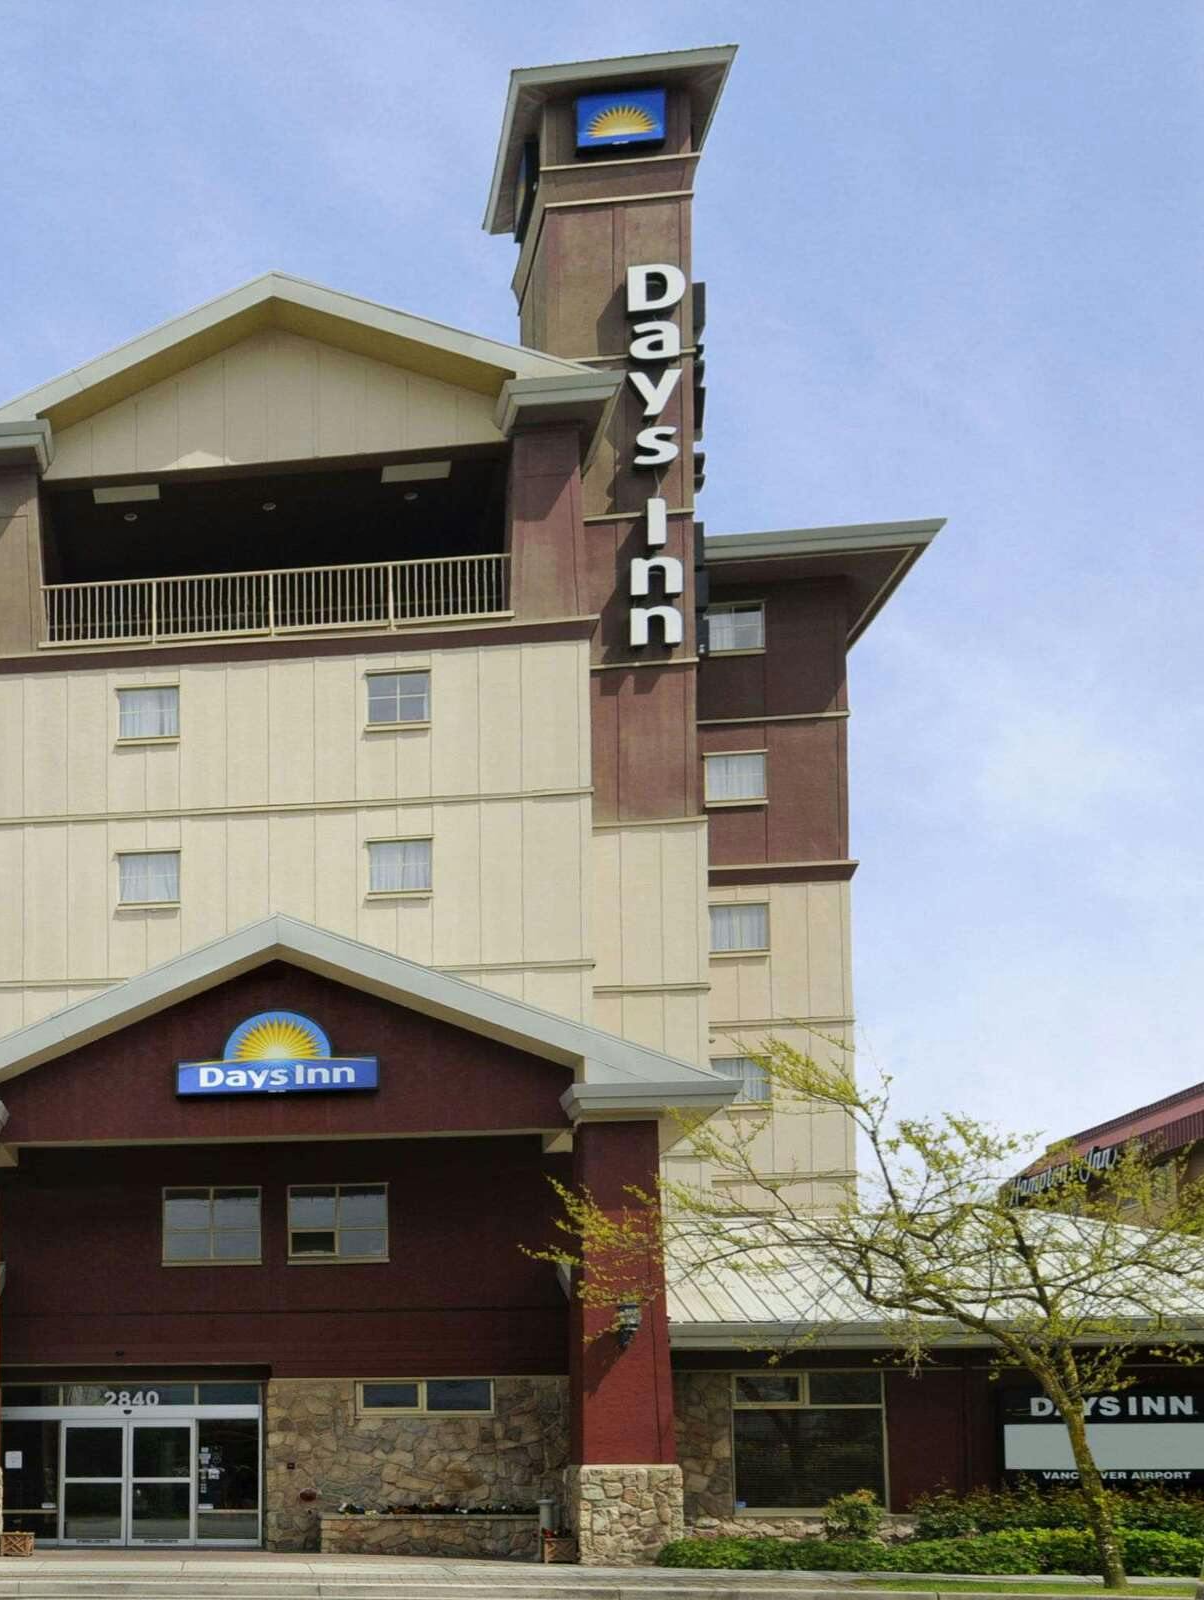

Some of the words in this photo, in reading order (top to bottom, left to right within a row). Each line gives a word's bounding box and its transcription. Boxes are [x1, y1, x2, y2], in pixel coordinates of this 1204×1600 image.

[627, 263, 686, 466] Days
[629, 498, 684, 647] Inn
[198, 1066, 289, 1089] Days
[295, 1064, 356, 1085] Inn
[103, 1390, 160, 1406] 2840
[1029, 1396, 1121, 1417] DYS
[1128, 1395, 1194, 1416] INN
[1042, 1471, 1127, 1480] VANCVER
[1131, 1471, 1192, 1480] AIRPORT
